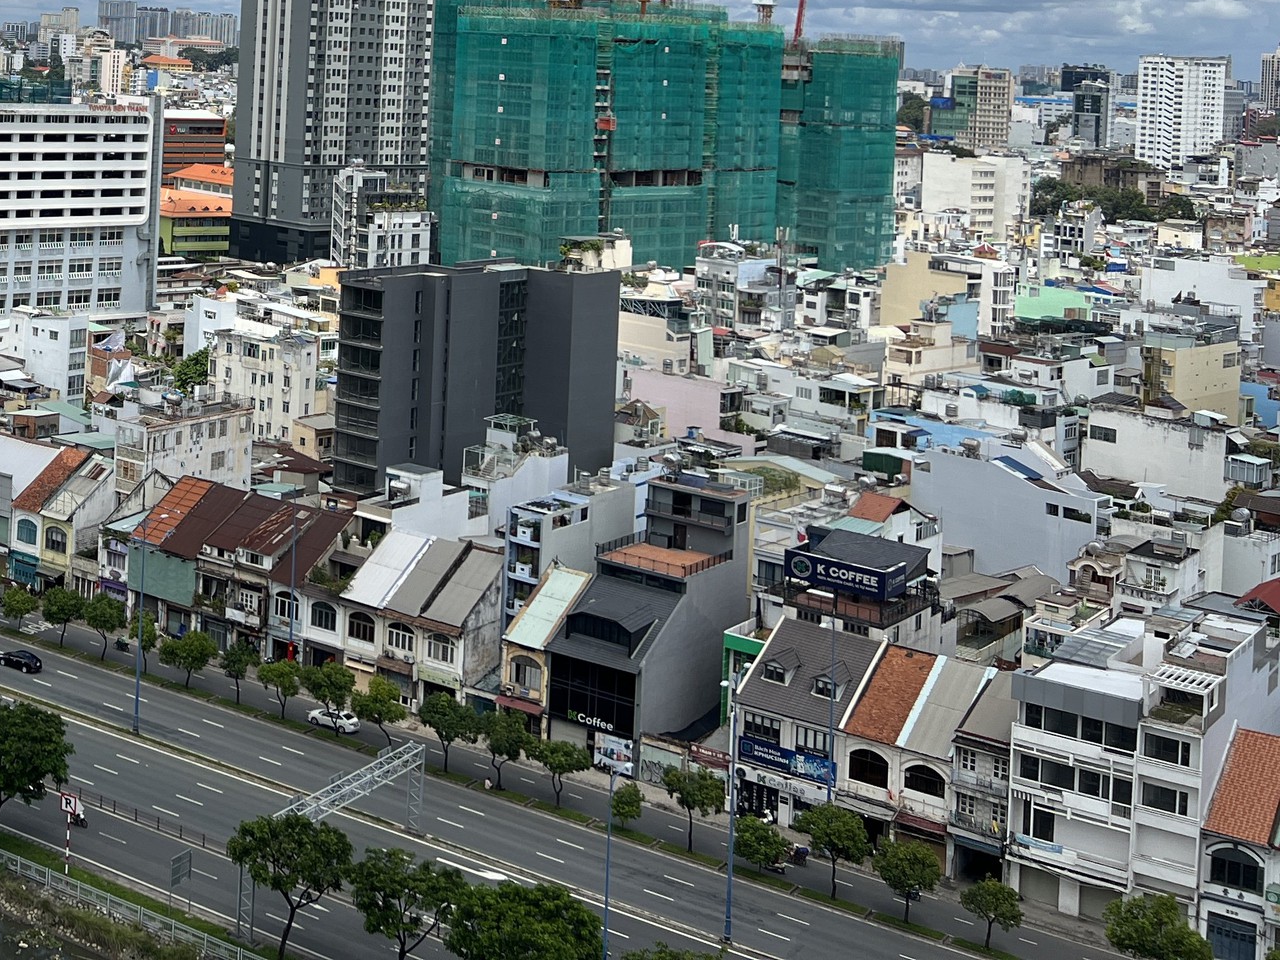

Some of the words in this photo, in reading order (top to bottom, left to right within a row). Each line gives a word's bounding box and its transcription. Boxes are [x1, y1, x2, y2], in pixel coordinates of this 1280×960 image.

[816, 563, 826, 575] K
[828, 566, 879, 587] COFFEE
[577, 713, 614, 732] Coffee
[768, 776, 806, 796] Coffee
[65, 797, 73, 809] R
